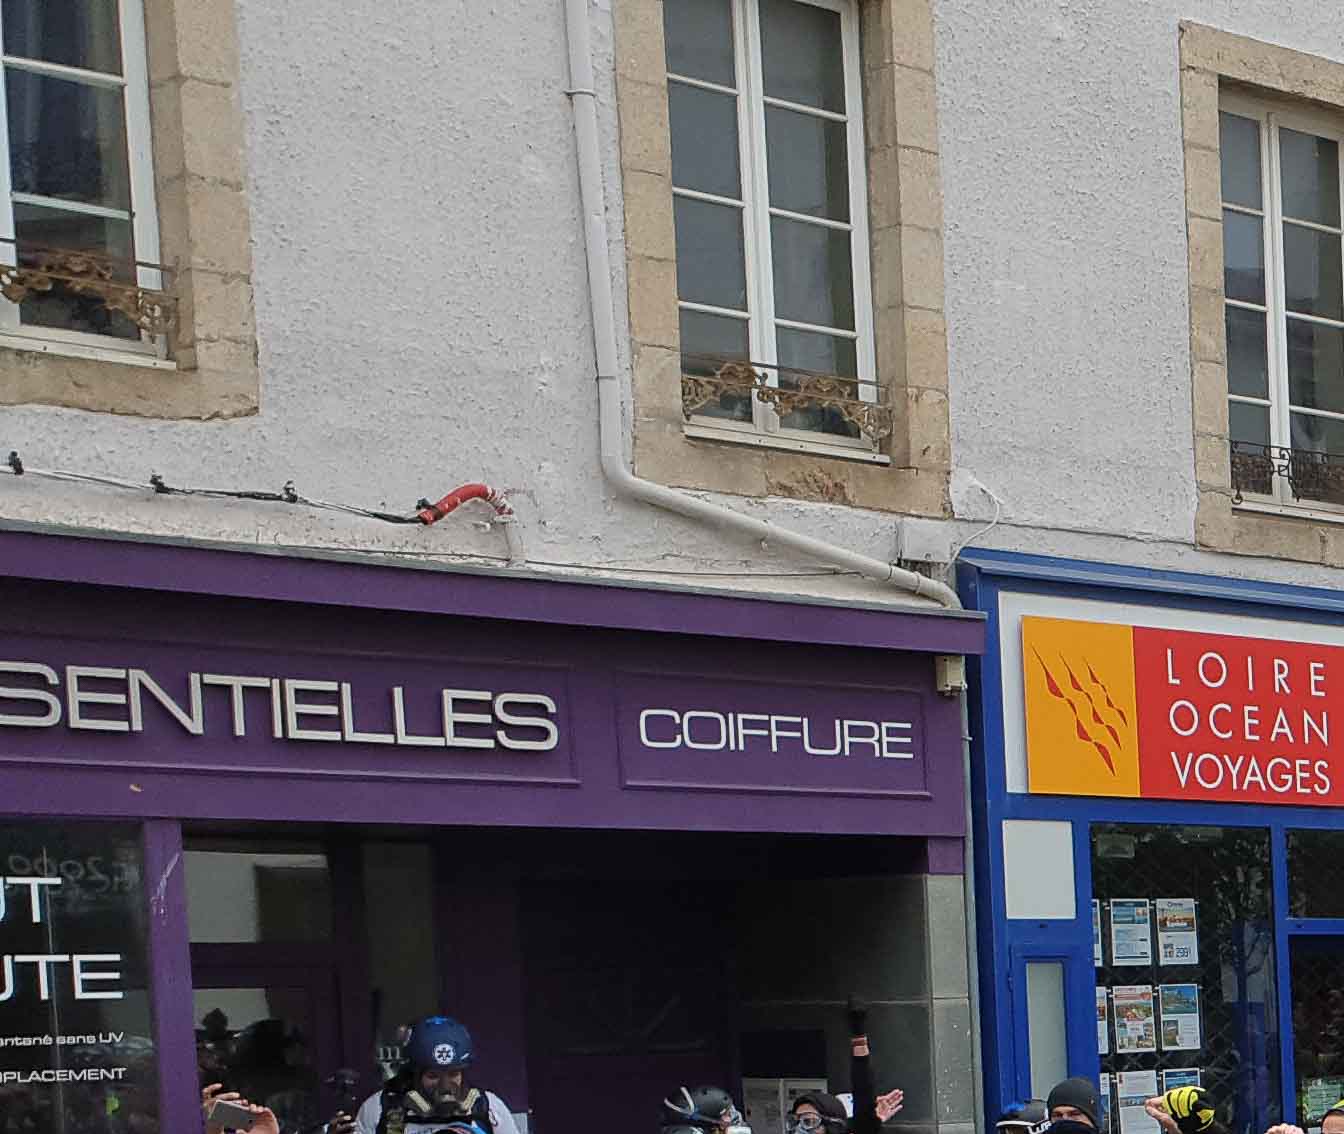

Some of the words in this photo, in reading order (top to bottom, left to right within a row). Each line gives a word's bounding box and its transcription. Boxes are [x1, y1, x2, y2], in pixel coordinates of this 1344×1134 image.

[1166, 647, 1328, 697] LOIRE
[639, 708, 914, 759] COIFFURE
[1168, 700, 1329, 746] OCEAN
[1170, 751, 1331, 795] VOYAGES
[56, 1034, 96, 1045] sans
[99, 1031, 124, 1043] UV
